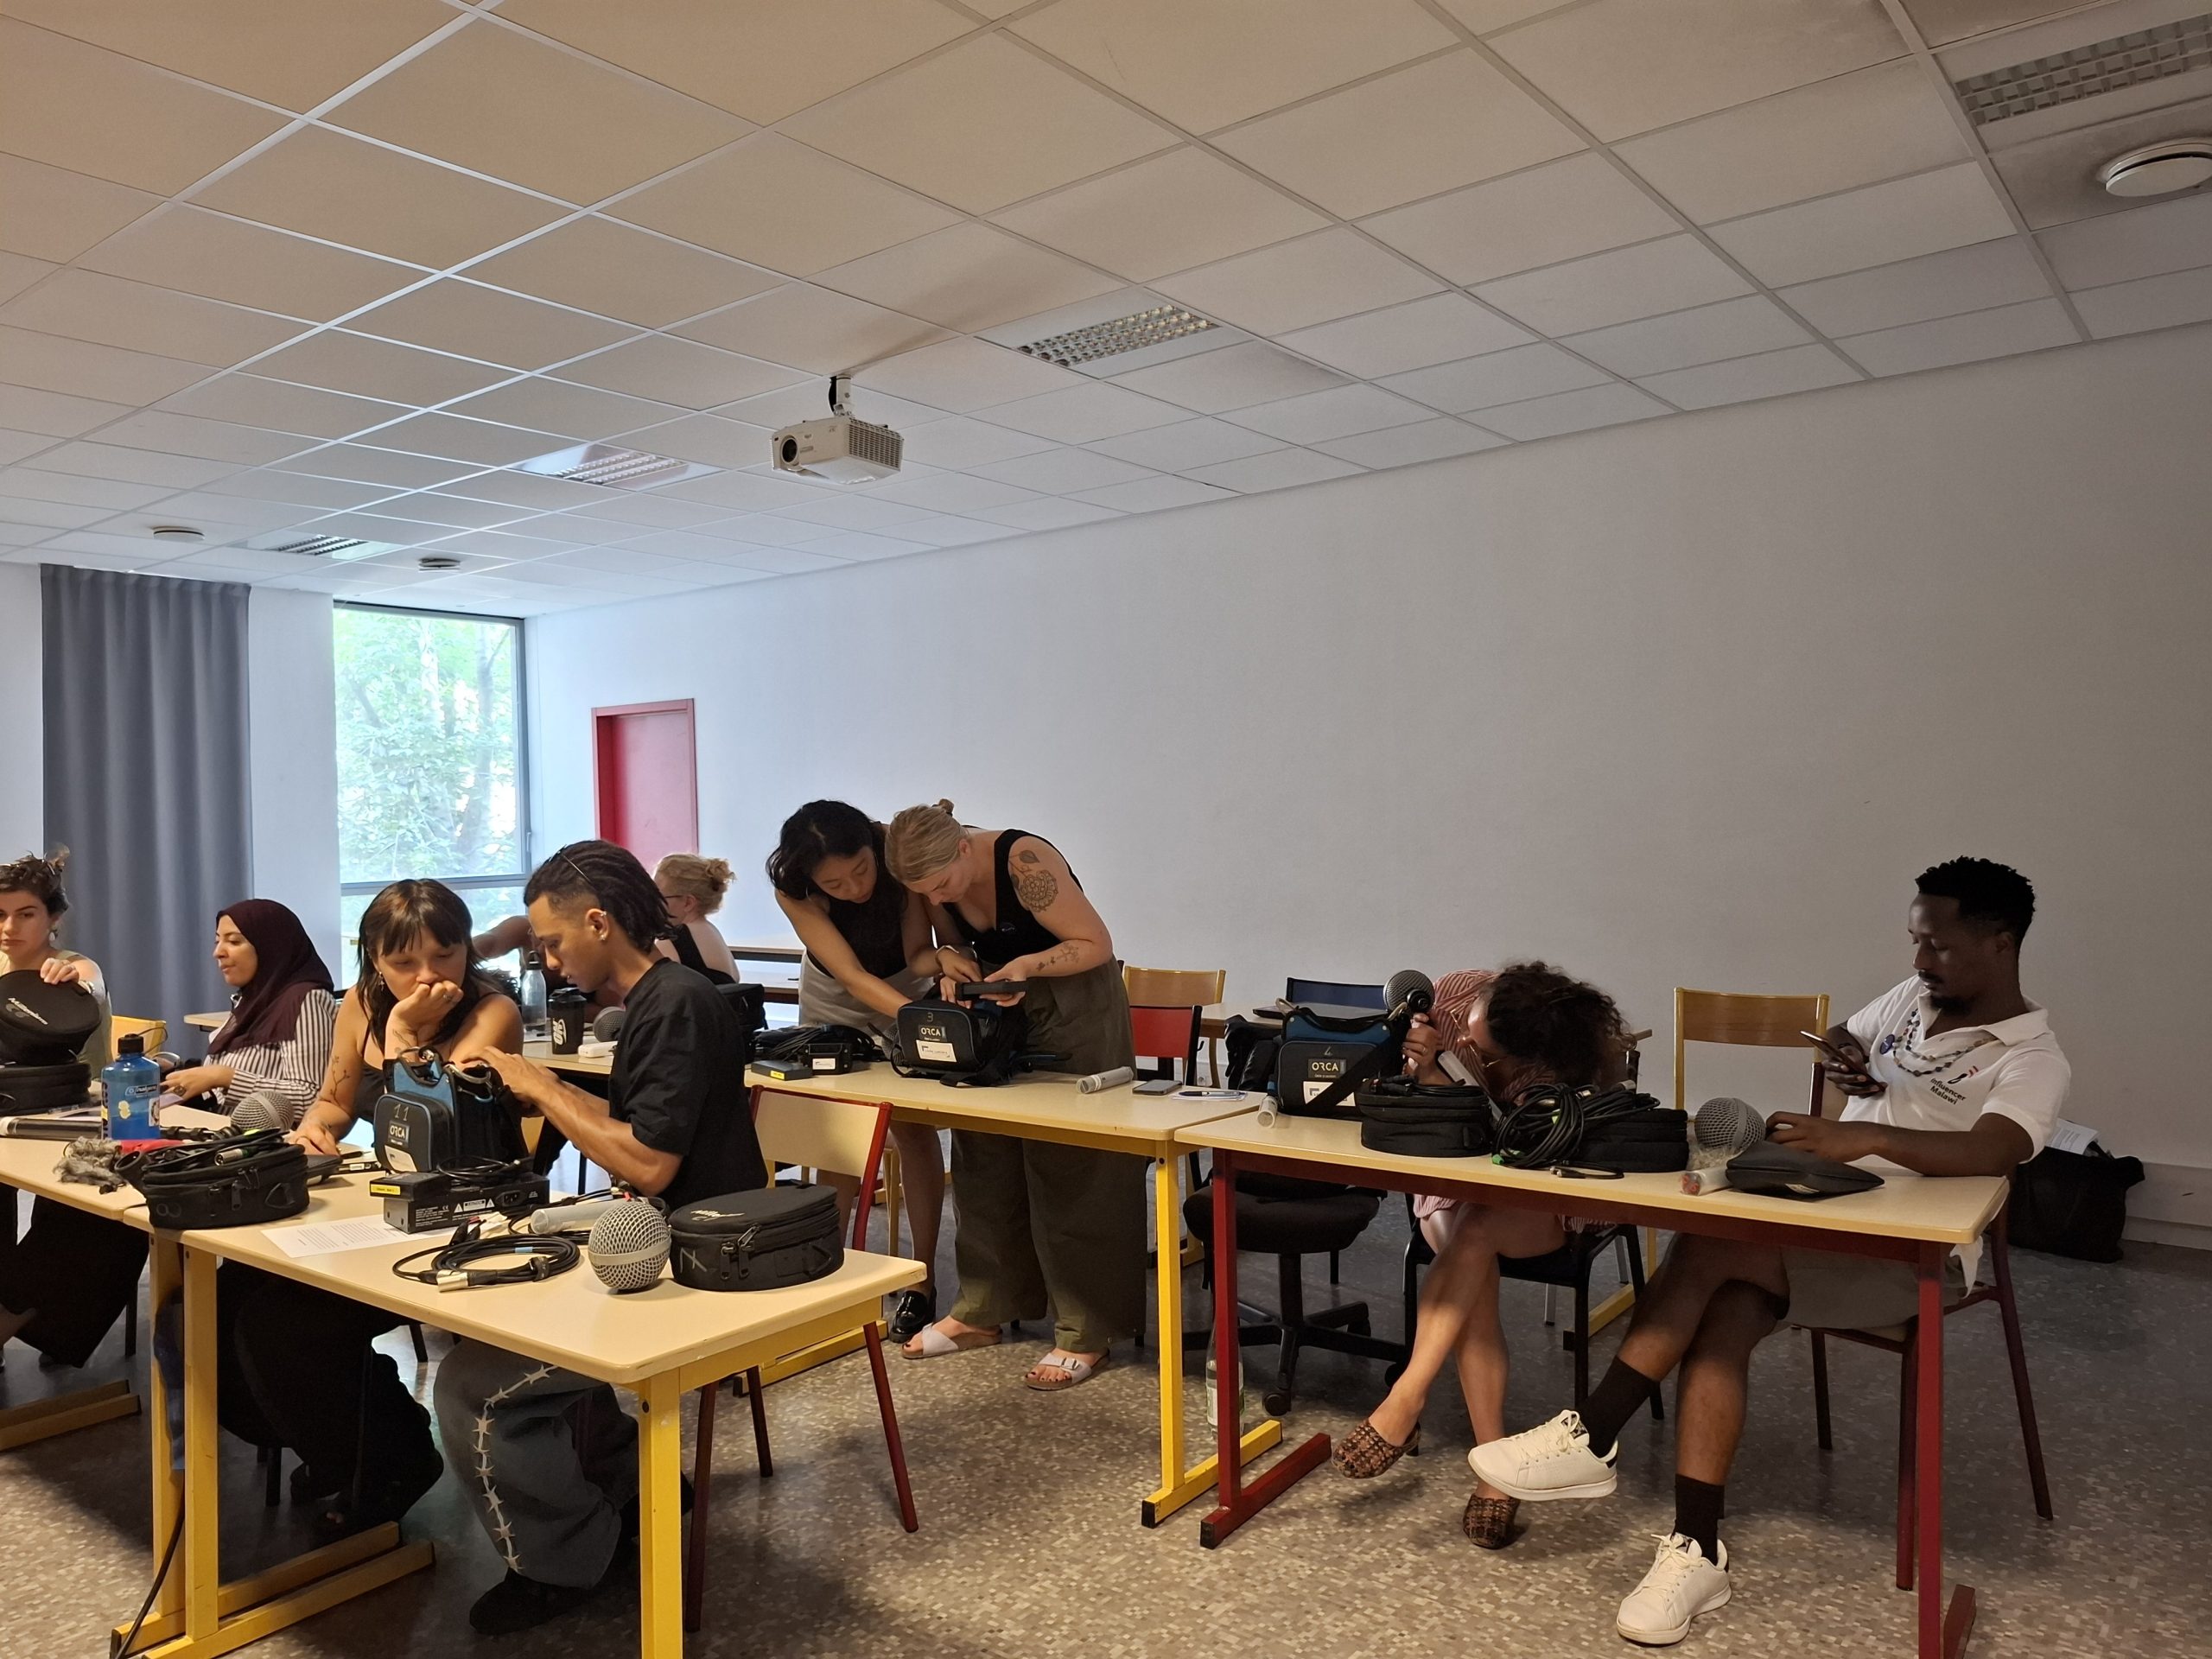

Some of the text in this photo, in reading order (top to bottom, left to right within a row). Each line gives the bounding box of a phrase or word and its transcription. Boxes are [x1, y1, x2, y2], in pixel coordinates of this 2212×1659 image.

[926, 1012, 934, 1022] 3
[920, 1027, 941, 1036] ORCA
[1312, 1062, 1339, 1071] ORCA
[1929, 1085, 1958, 1105] Malawi
[393, 1103, 410, 1122] 11
[390, 1125, 405, 1139] ORCA
